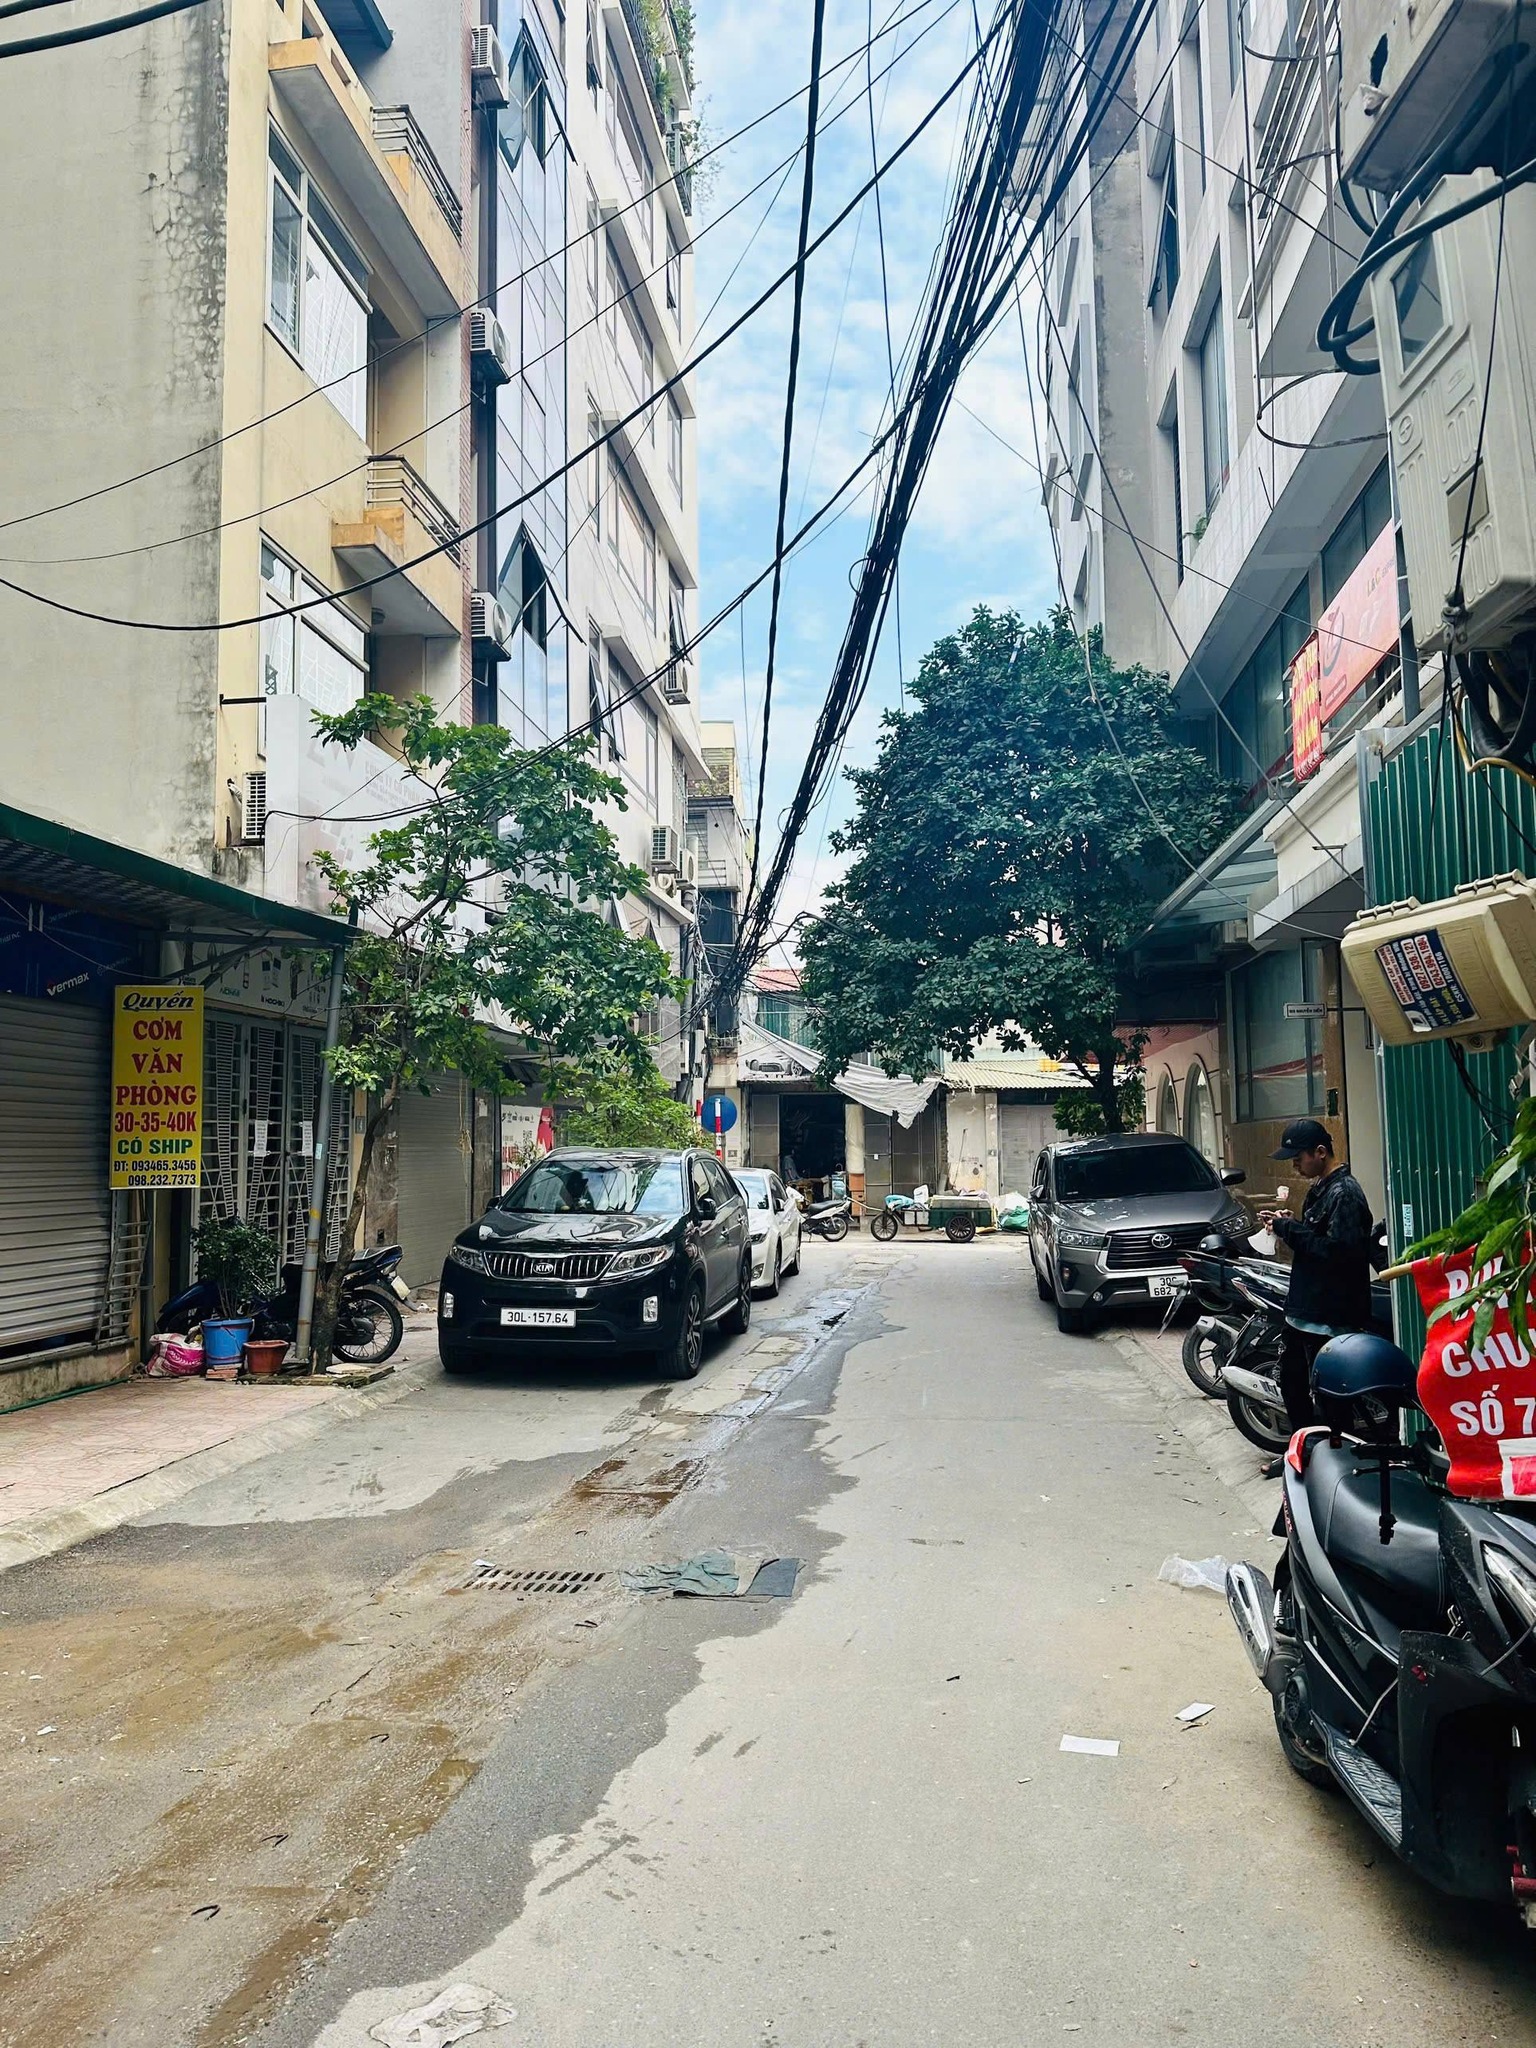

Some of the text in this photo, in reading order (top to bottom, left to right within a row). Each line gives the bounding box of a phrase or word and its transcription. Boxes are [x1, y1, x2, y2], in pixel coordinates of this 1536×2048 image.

[47, 972, 90, 996] vermax
[133, 1016, 183, 1041] CƠM
[131, 1047, 183, 1074] VĂN
[115, 1080, 197, 1106] PHÒNG
[114, 1111, 197, 1133] 30-35-40K
[117, 1136, 193, 1155] CÓ SHIP
[114, 1159, 196, 1172] ĐT: 093465.3456
[128, 1174, 196, 1186] 098.232.7373
[535, 1264, 552, 1272] KIA
[1442, 1328, 1536, 1378] CHU
[1450, 1384, 1536, 1436] SỐ 7
